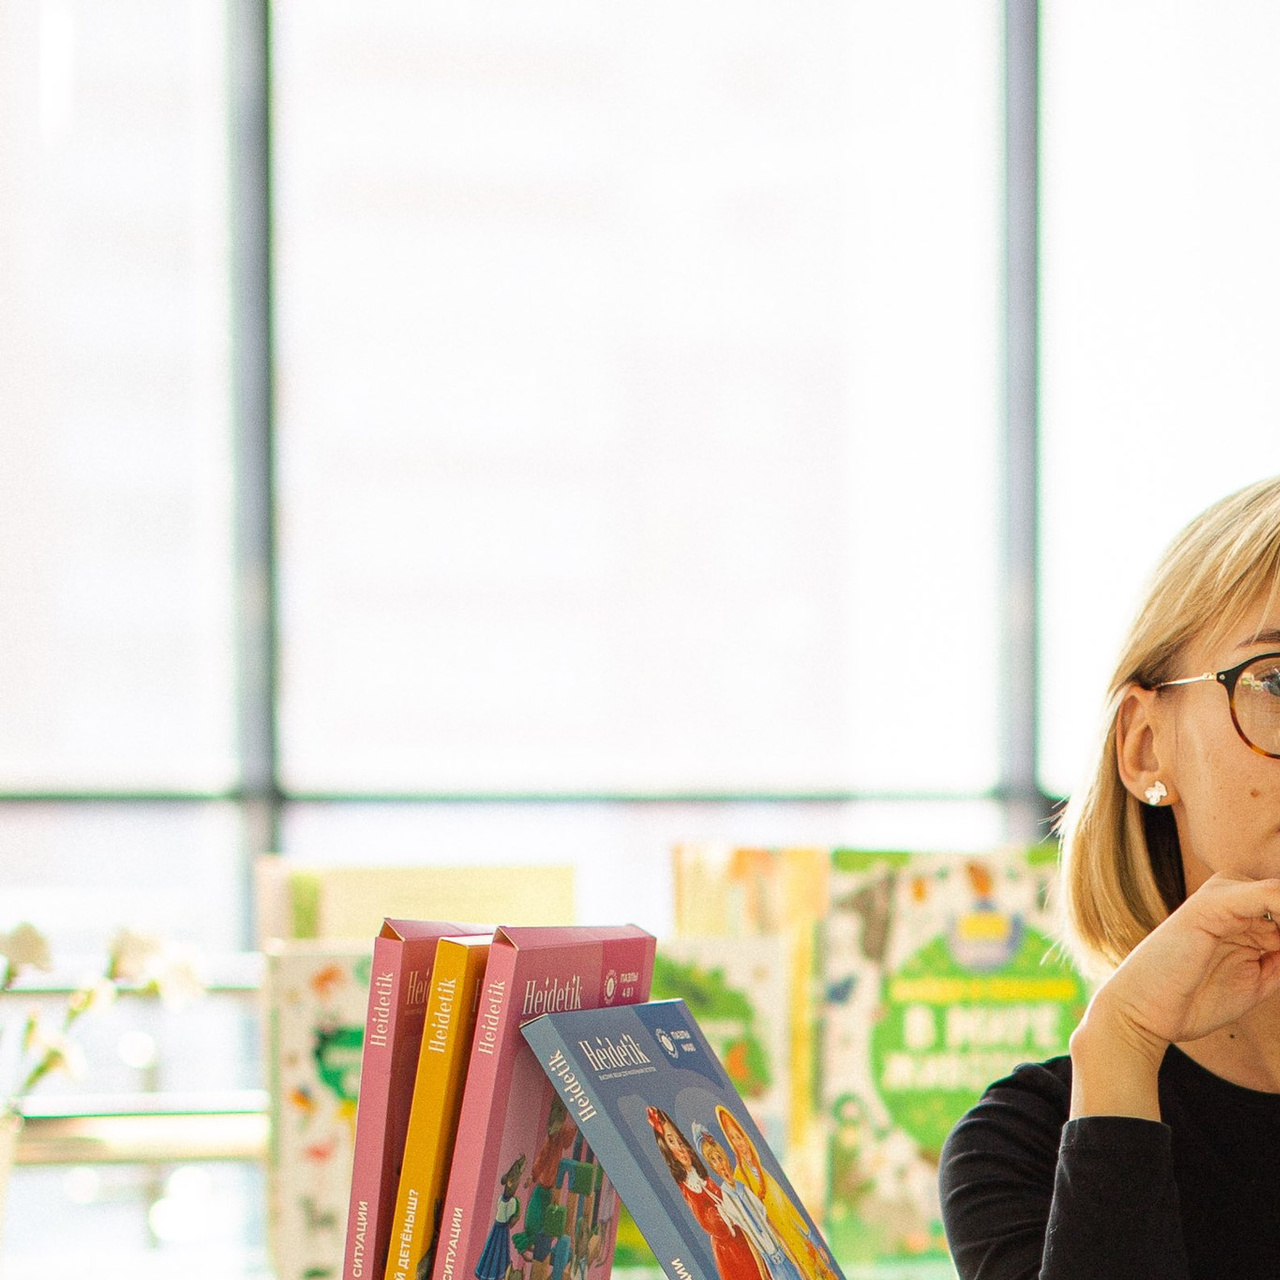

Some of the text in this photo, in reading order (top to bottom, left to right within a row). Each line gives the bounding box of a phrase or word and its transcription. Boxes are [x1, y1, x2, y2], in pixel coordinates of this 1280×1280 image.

[370, 971, 394, 1047] Heidetik
[428, 977, 457, 1054] Heidetik
[478, 979, 505, 1055] Heidetik
[521, 975, 583, 1015] Heidetik
[548, 1050, 597, 1123] Heidetik
[578, 1032, 651, 1072] Heidetik
[352, 1200, 369, 1278] СИТУАЦИИ
[398, 1188, 419, 1270] ДЕТЁНЫШ?
